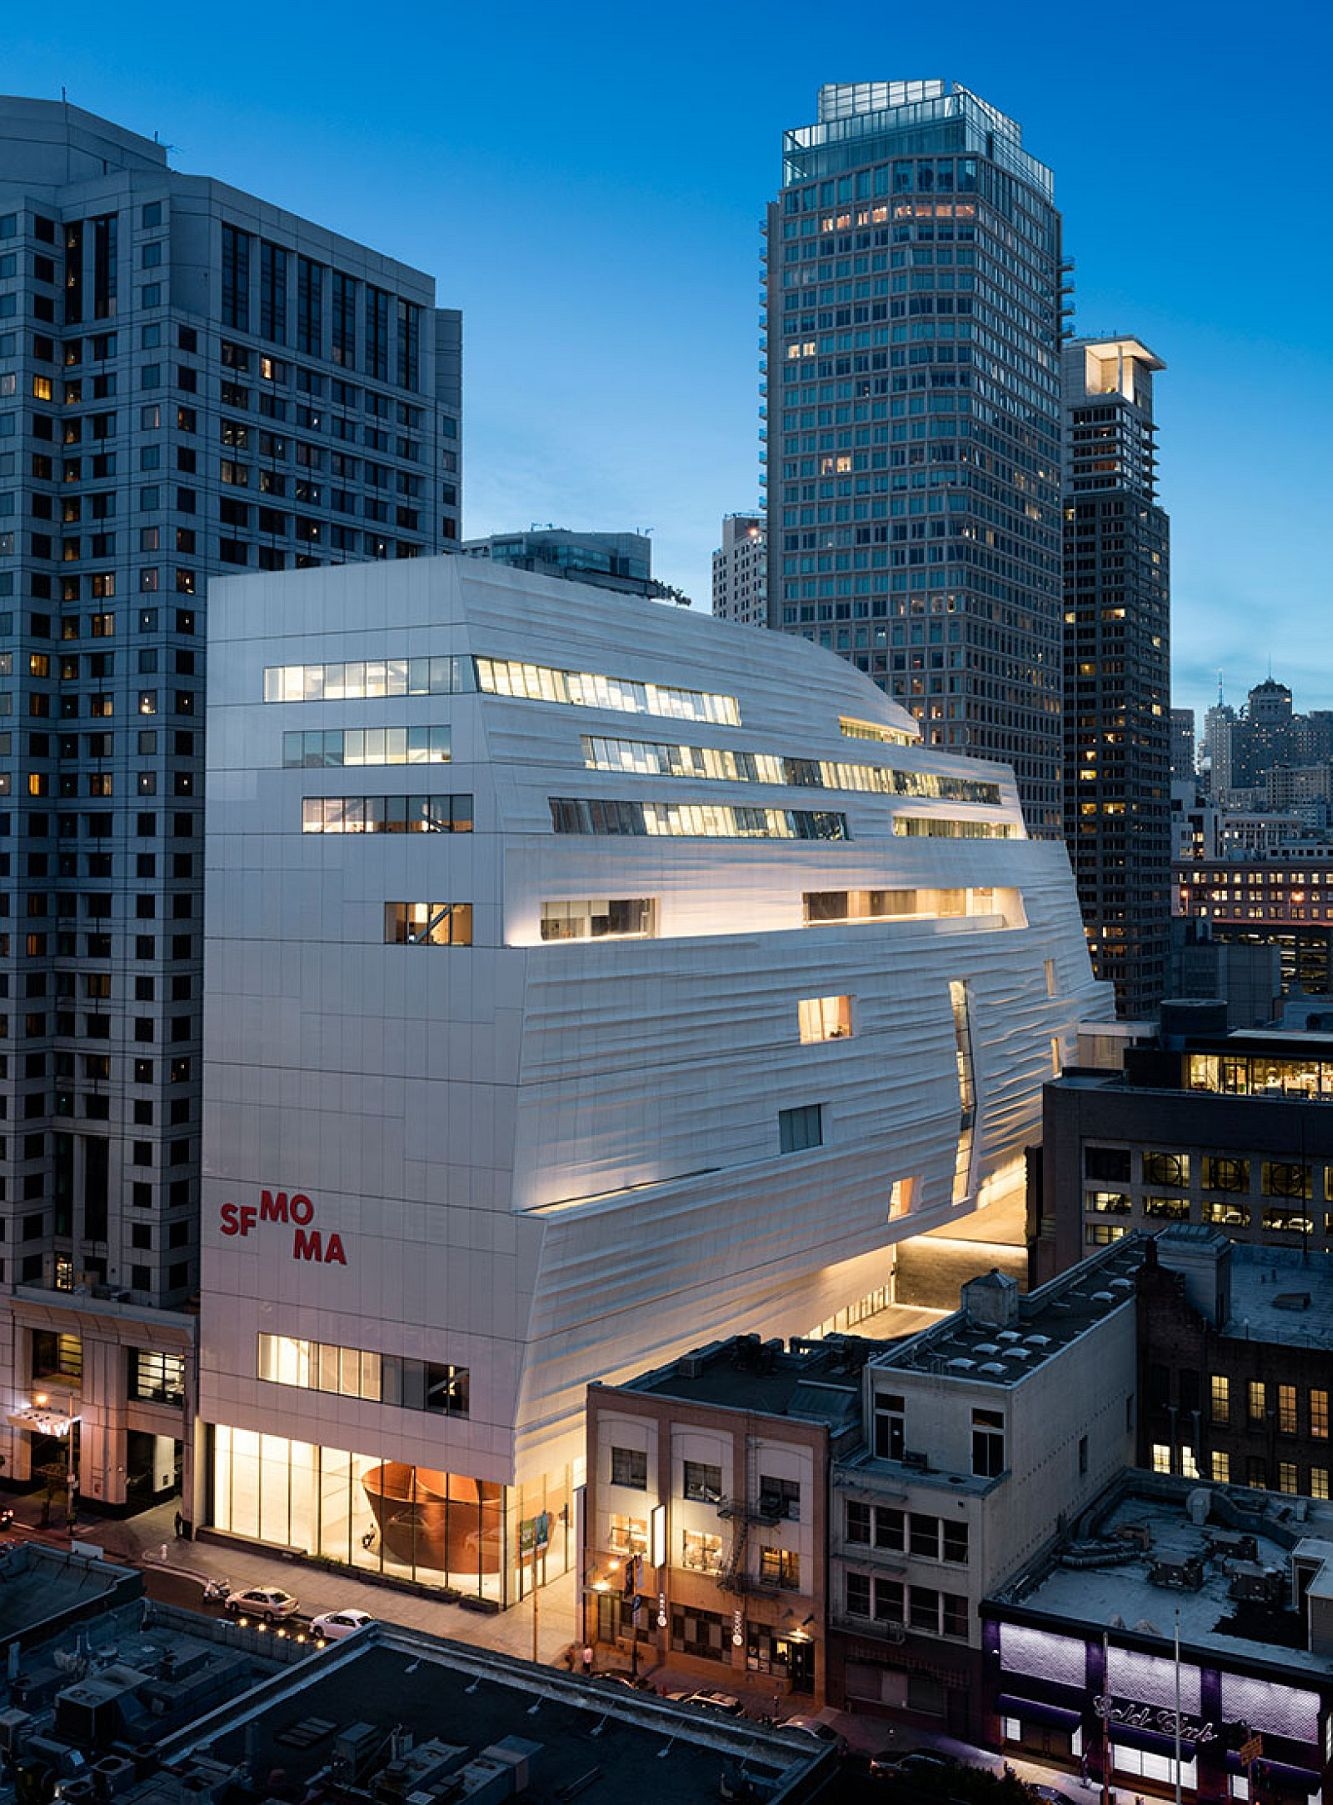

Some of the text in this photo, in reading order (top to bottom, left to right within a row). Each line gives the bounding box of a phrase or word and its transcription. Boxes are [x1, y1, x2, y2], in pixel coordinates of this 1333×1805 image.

[220, 1189, 315, 1236] SF MO
[293, 1228, 348, 1266] MA
[1093, 1695, 1152, 1726] Gold
